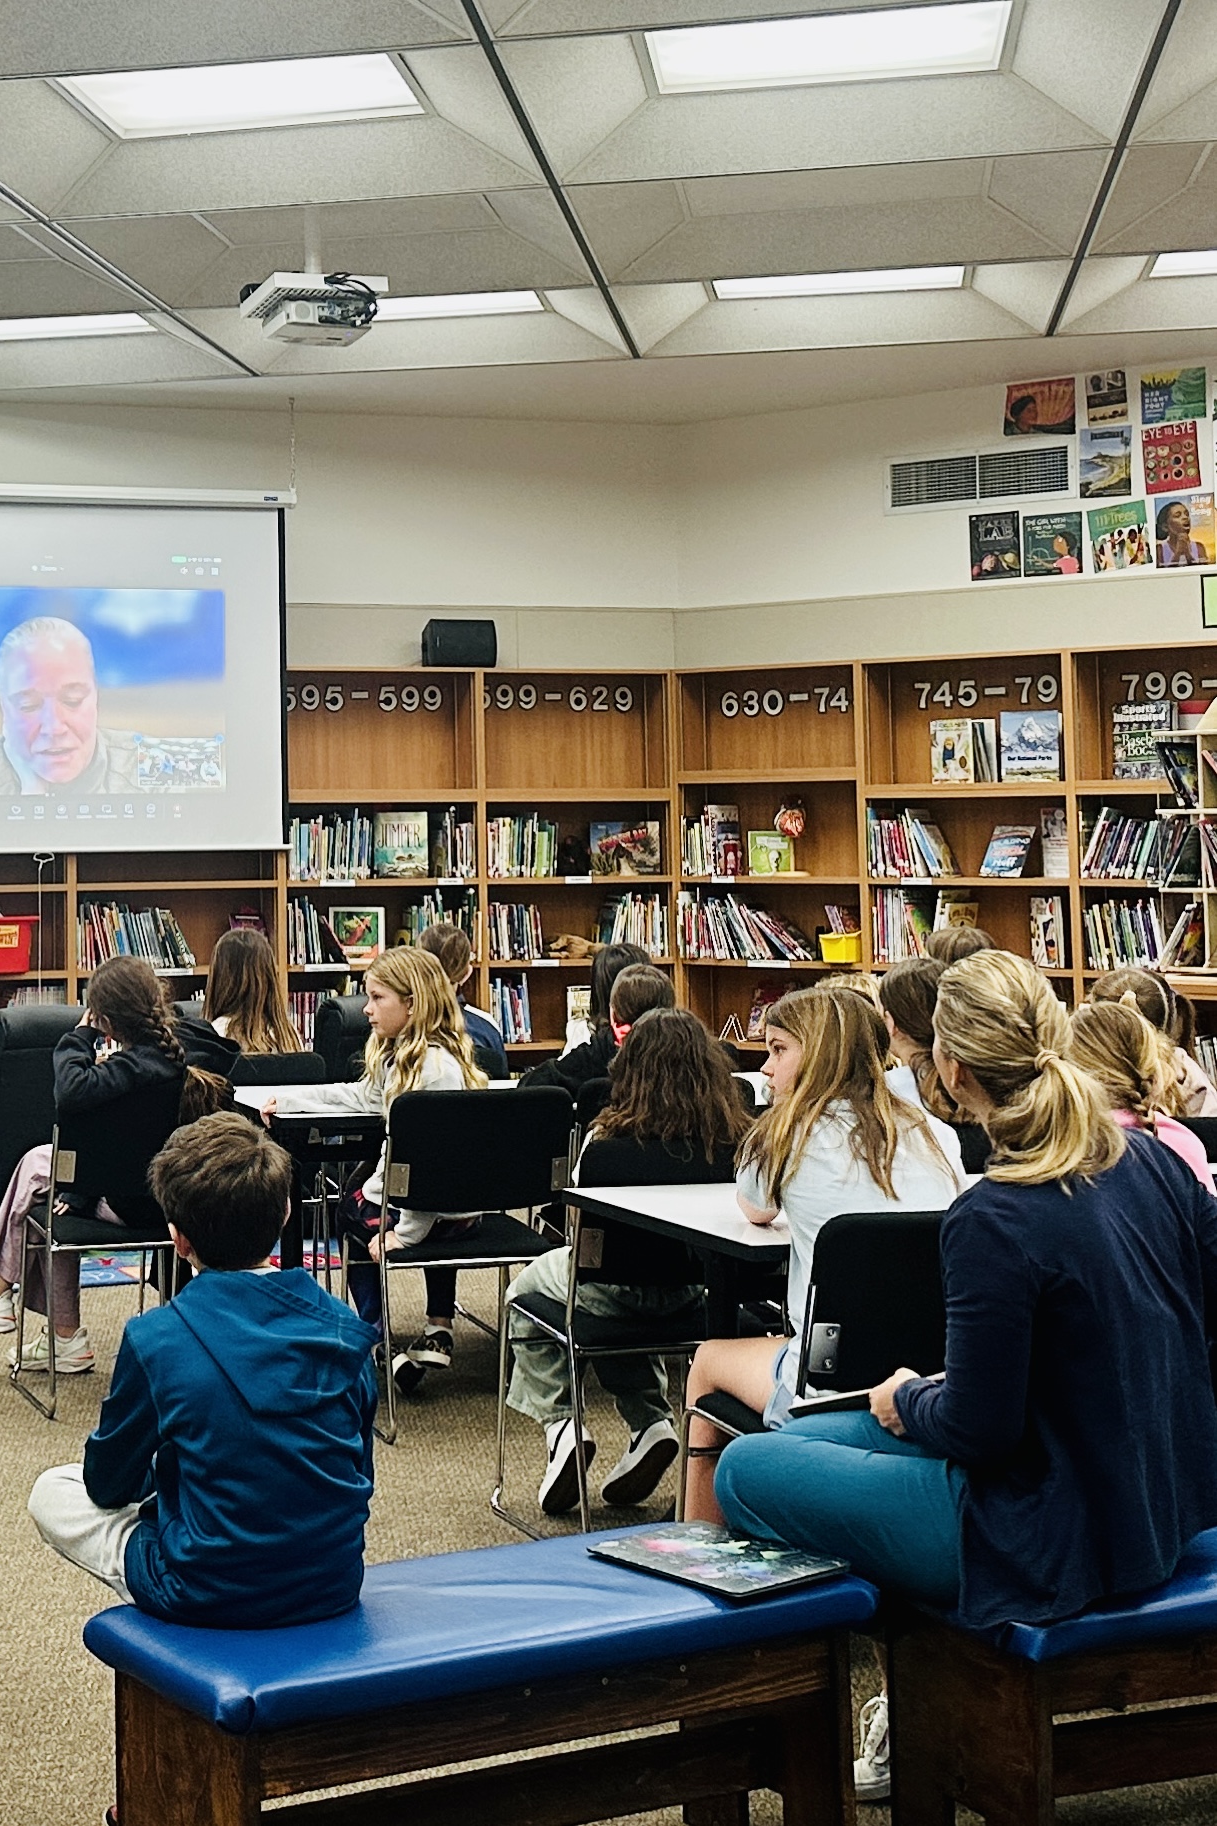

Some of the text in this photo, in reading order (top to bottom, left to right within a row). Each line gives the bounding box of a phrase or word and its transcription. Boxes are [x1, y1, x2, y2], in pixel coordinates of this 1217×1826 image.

[1142, 428, 1163, 441] EYE
[1173, 421, 1195, 436] EYE
[1110, 511, 1138, 524] Trees
[1122, 705, 1156, 715] Sports
[377, 823, 423, 848] JUMPER
